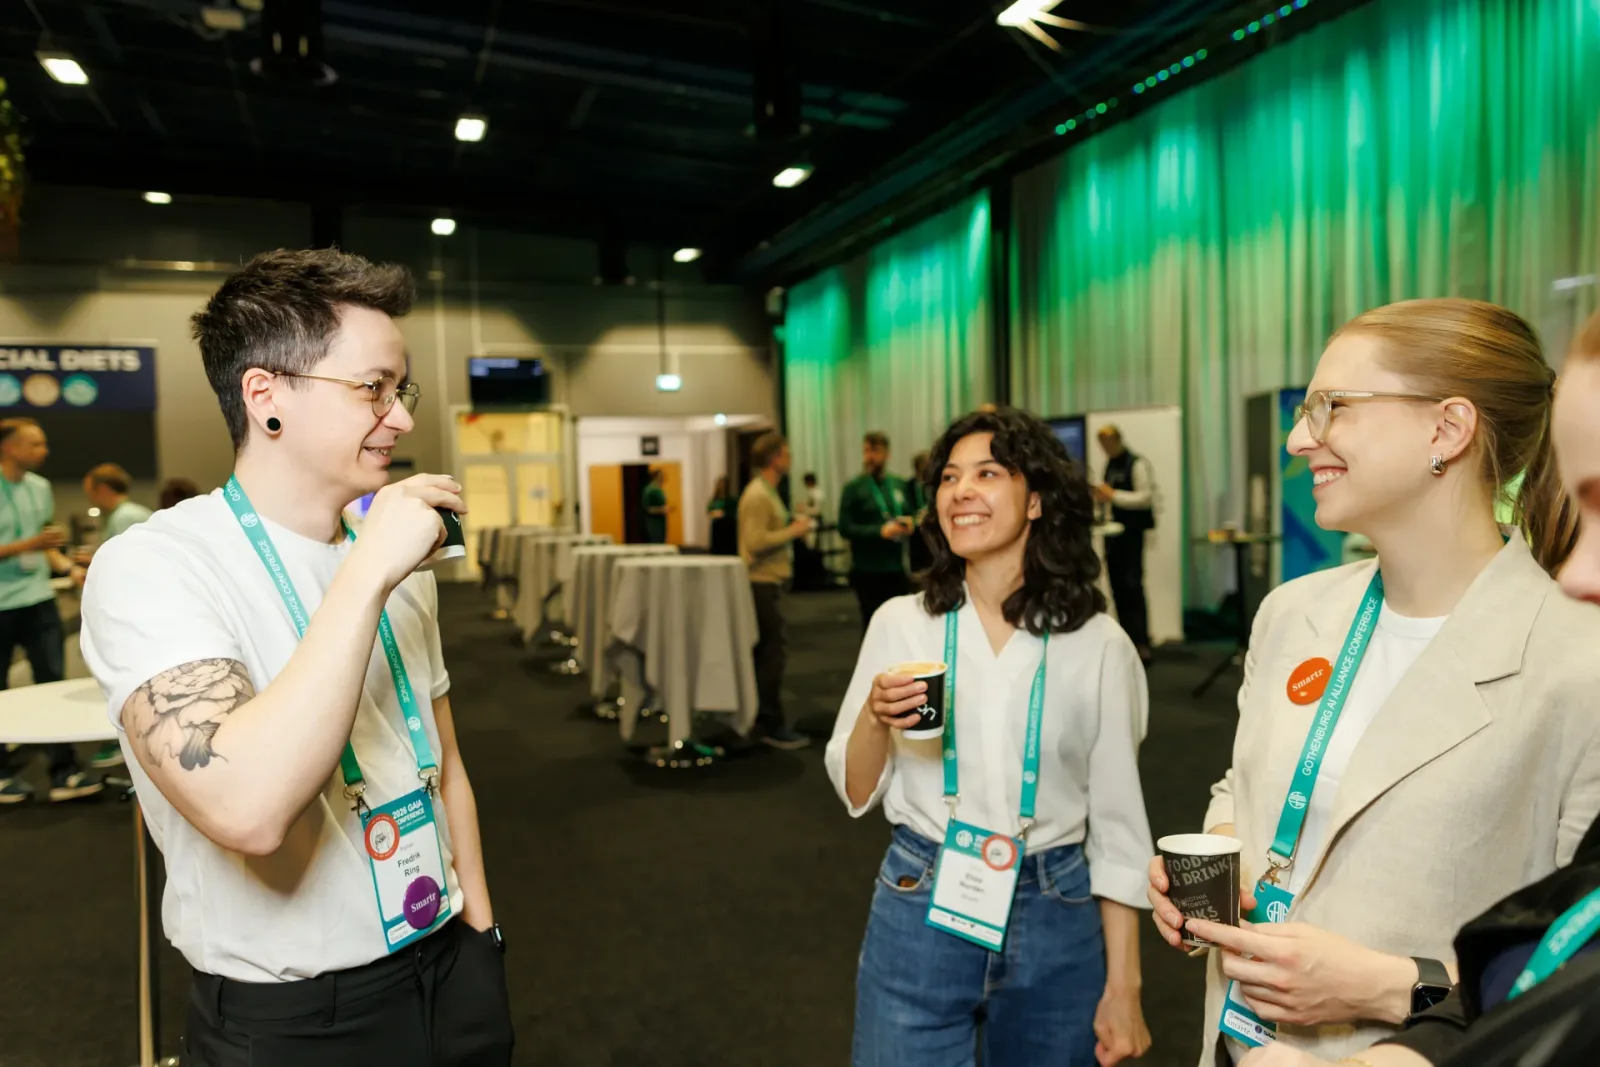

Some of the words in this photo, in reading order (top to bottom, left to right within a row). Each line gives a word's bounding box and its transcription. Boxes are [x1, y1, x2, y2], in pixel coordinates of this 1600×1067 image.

[59, 349, 141, 372] DIETS
[257, 539, 291, 594] CONFERENCE
[1348, 596, 1379, 654] CONFERENCE
[389, 648, 410, 703] CONFERENCE
[1292, 669, 1324, 692] Smartr
[1331, 655, 1355, 699] ALLIANCE
[1326, 698, 1338, 711] AI
[1302, 710, 1333, 776] GOTHENBURG
[408, 799, 424, 812] GAIA
[397, 852, 421, 867] Fredrik
[404, 865, 420, 877] Ring
[1167, 856, 1202, 872] FOOD
[411, 892, 436, 913] Smartr
